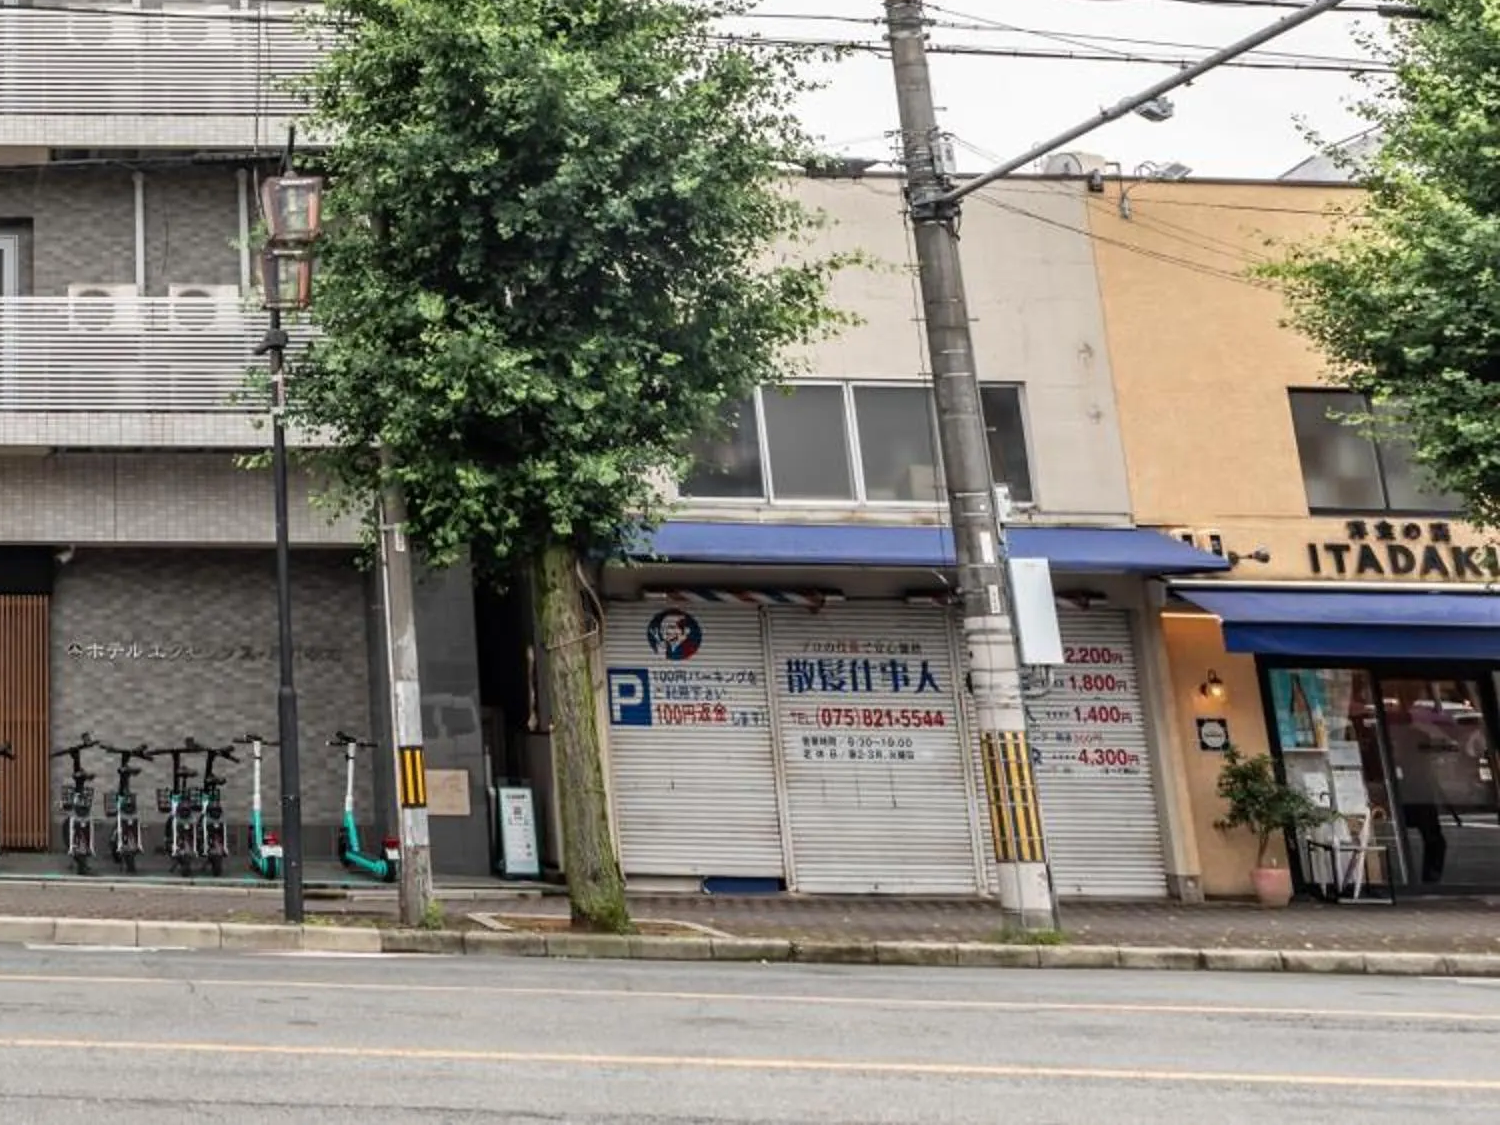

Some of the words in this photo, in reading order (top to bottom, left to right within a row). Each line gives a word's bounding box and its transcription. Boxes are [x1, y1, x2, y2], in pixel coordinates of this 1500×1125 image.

[787, 659, 943, 693] 散髪仕事人
[1069, 674, 1128, 693] 1,800円
[611, 674, 644, 722] P
[1074, 706, 1133, 724] 1,400円
[1078, 749, 1140, 767] 4,300円
